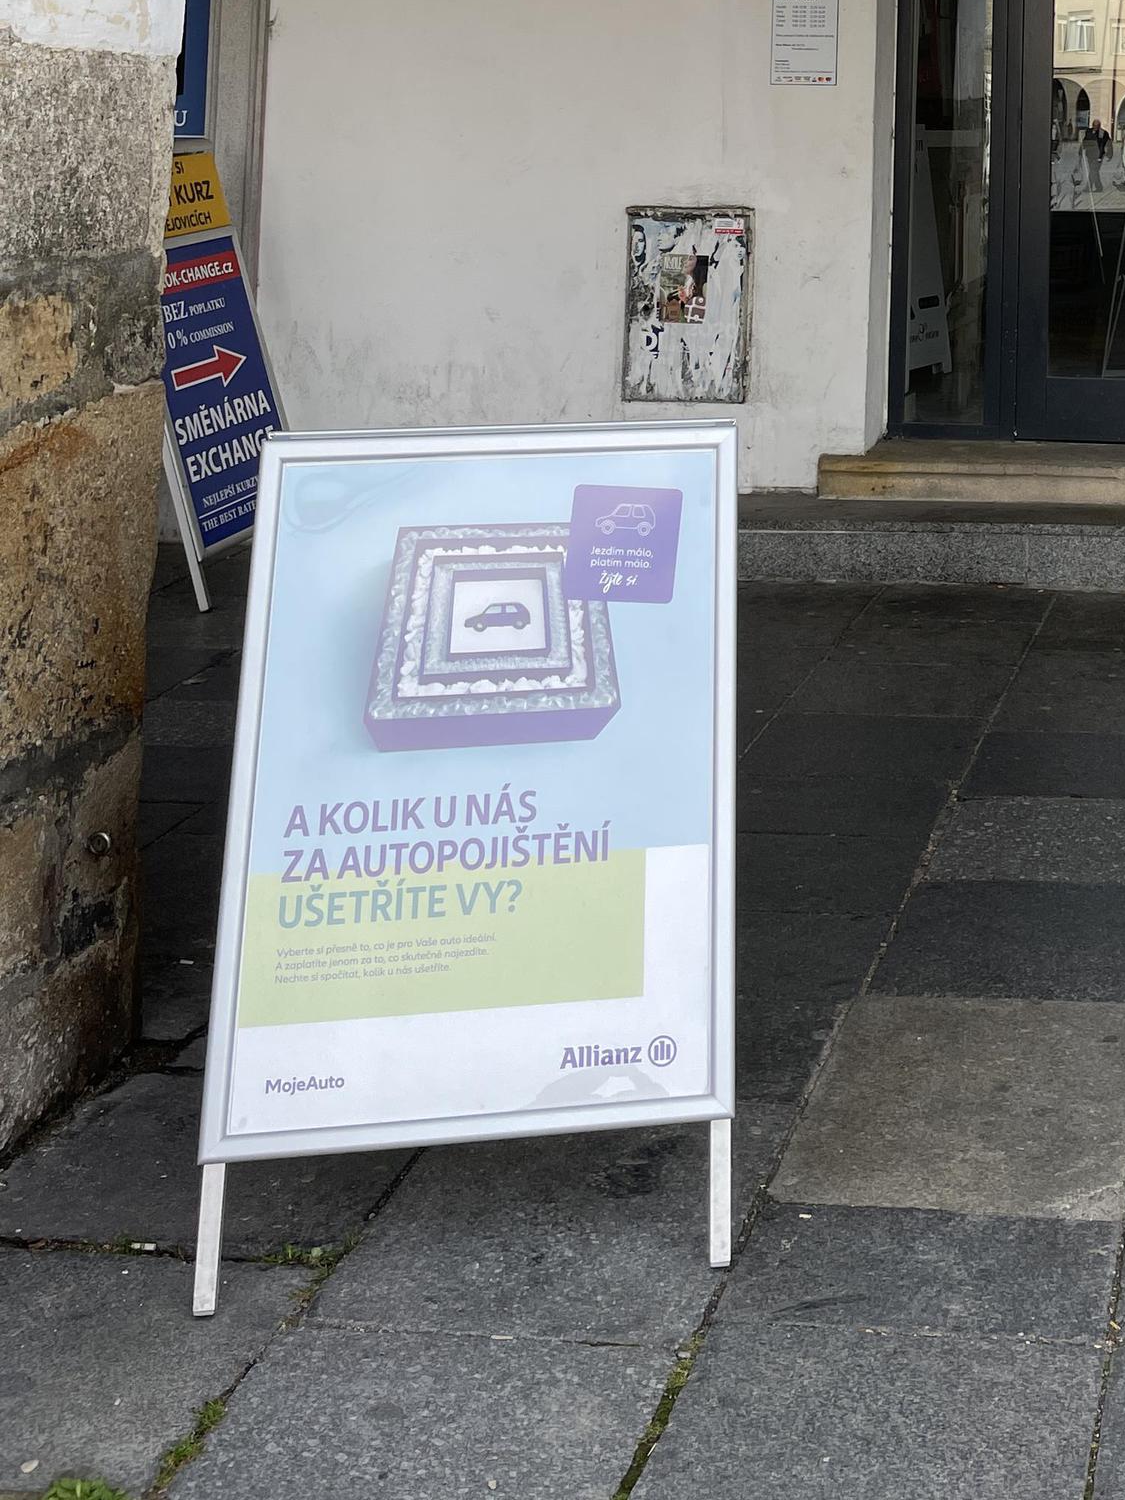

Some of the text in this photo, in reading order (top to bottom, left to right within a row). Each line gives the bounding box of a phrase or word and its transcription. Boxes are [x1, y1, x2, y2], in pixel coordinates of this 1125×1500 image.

[173, 180, 214, 205] KURZ
[162, 297, 226, 323] BEZ POPLATKU
[189, 321, 235, 343] COMMISSION
[174, 389, 272, 446] SMĚNÁRNA
[202, 517, 219, 532] THE
[219, 509, 238, 526] BEST
[283, 782, 538, 838] A KOLIK U NÁS
[280, 820, 611, 884] ZA AUTOPOJIŠTĚNÍ
[278, 878, 523, 929] UŠETŘÍTE VY?
[276, 947, 315, 959] Vyberte
[316, 945, 324, 955] si
[326, 943, 358, 956] přesně
[374, 943, 385, 951] co
[386, 940, 395, 952] je
[397, 940, 413, 952] pro
[415, 936, 438, 947] Vaše
[440, 935, 462, 946] auto
[275, 961, 284, 971] A
[284, 958, 327, 972] zaplatíte
[327, 957, 358, 969] jenom
[360, 956, 372, 965] za
[388, 954, 399, 963] co
[400, 949, 442, 962] skutečně
[274, 973, 309, 984] Nechte
[310, 971, 319, 981] si
[363, 966, 385, 978] kolik
[387, 967, 394, 976] u
[395, 965, 412, 975] nás
[560, 1043, 643, 1071] Allianz
[265, 1074, 345, 1096] MojeAuto
